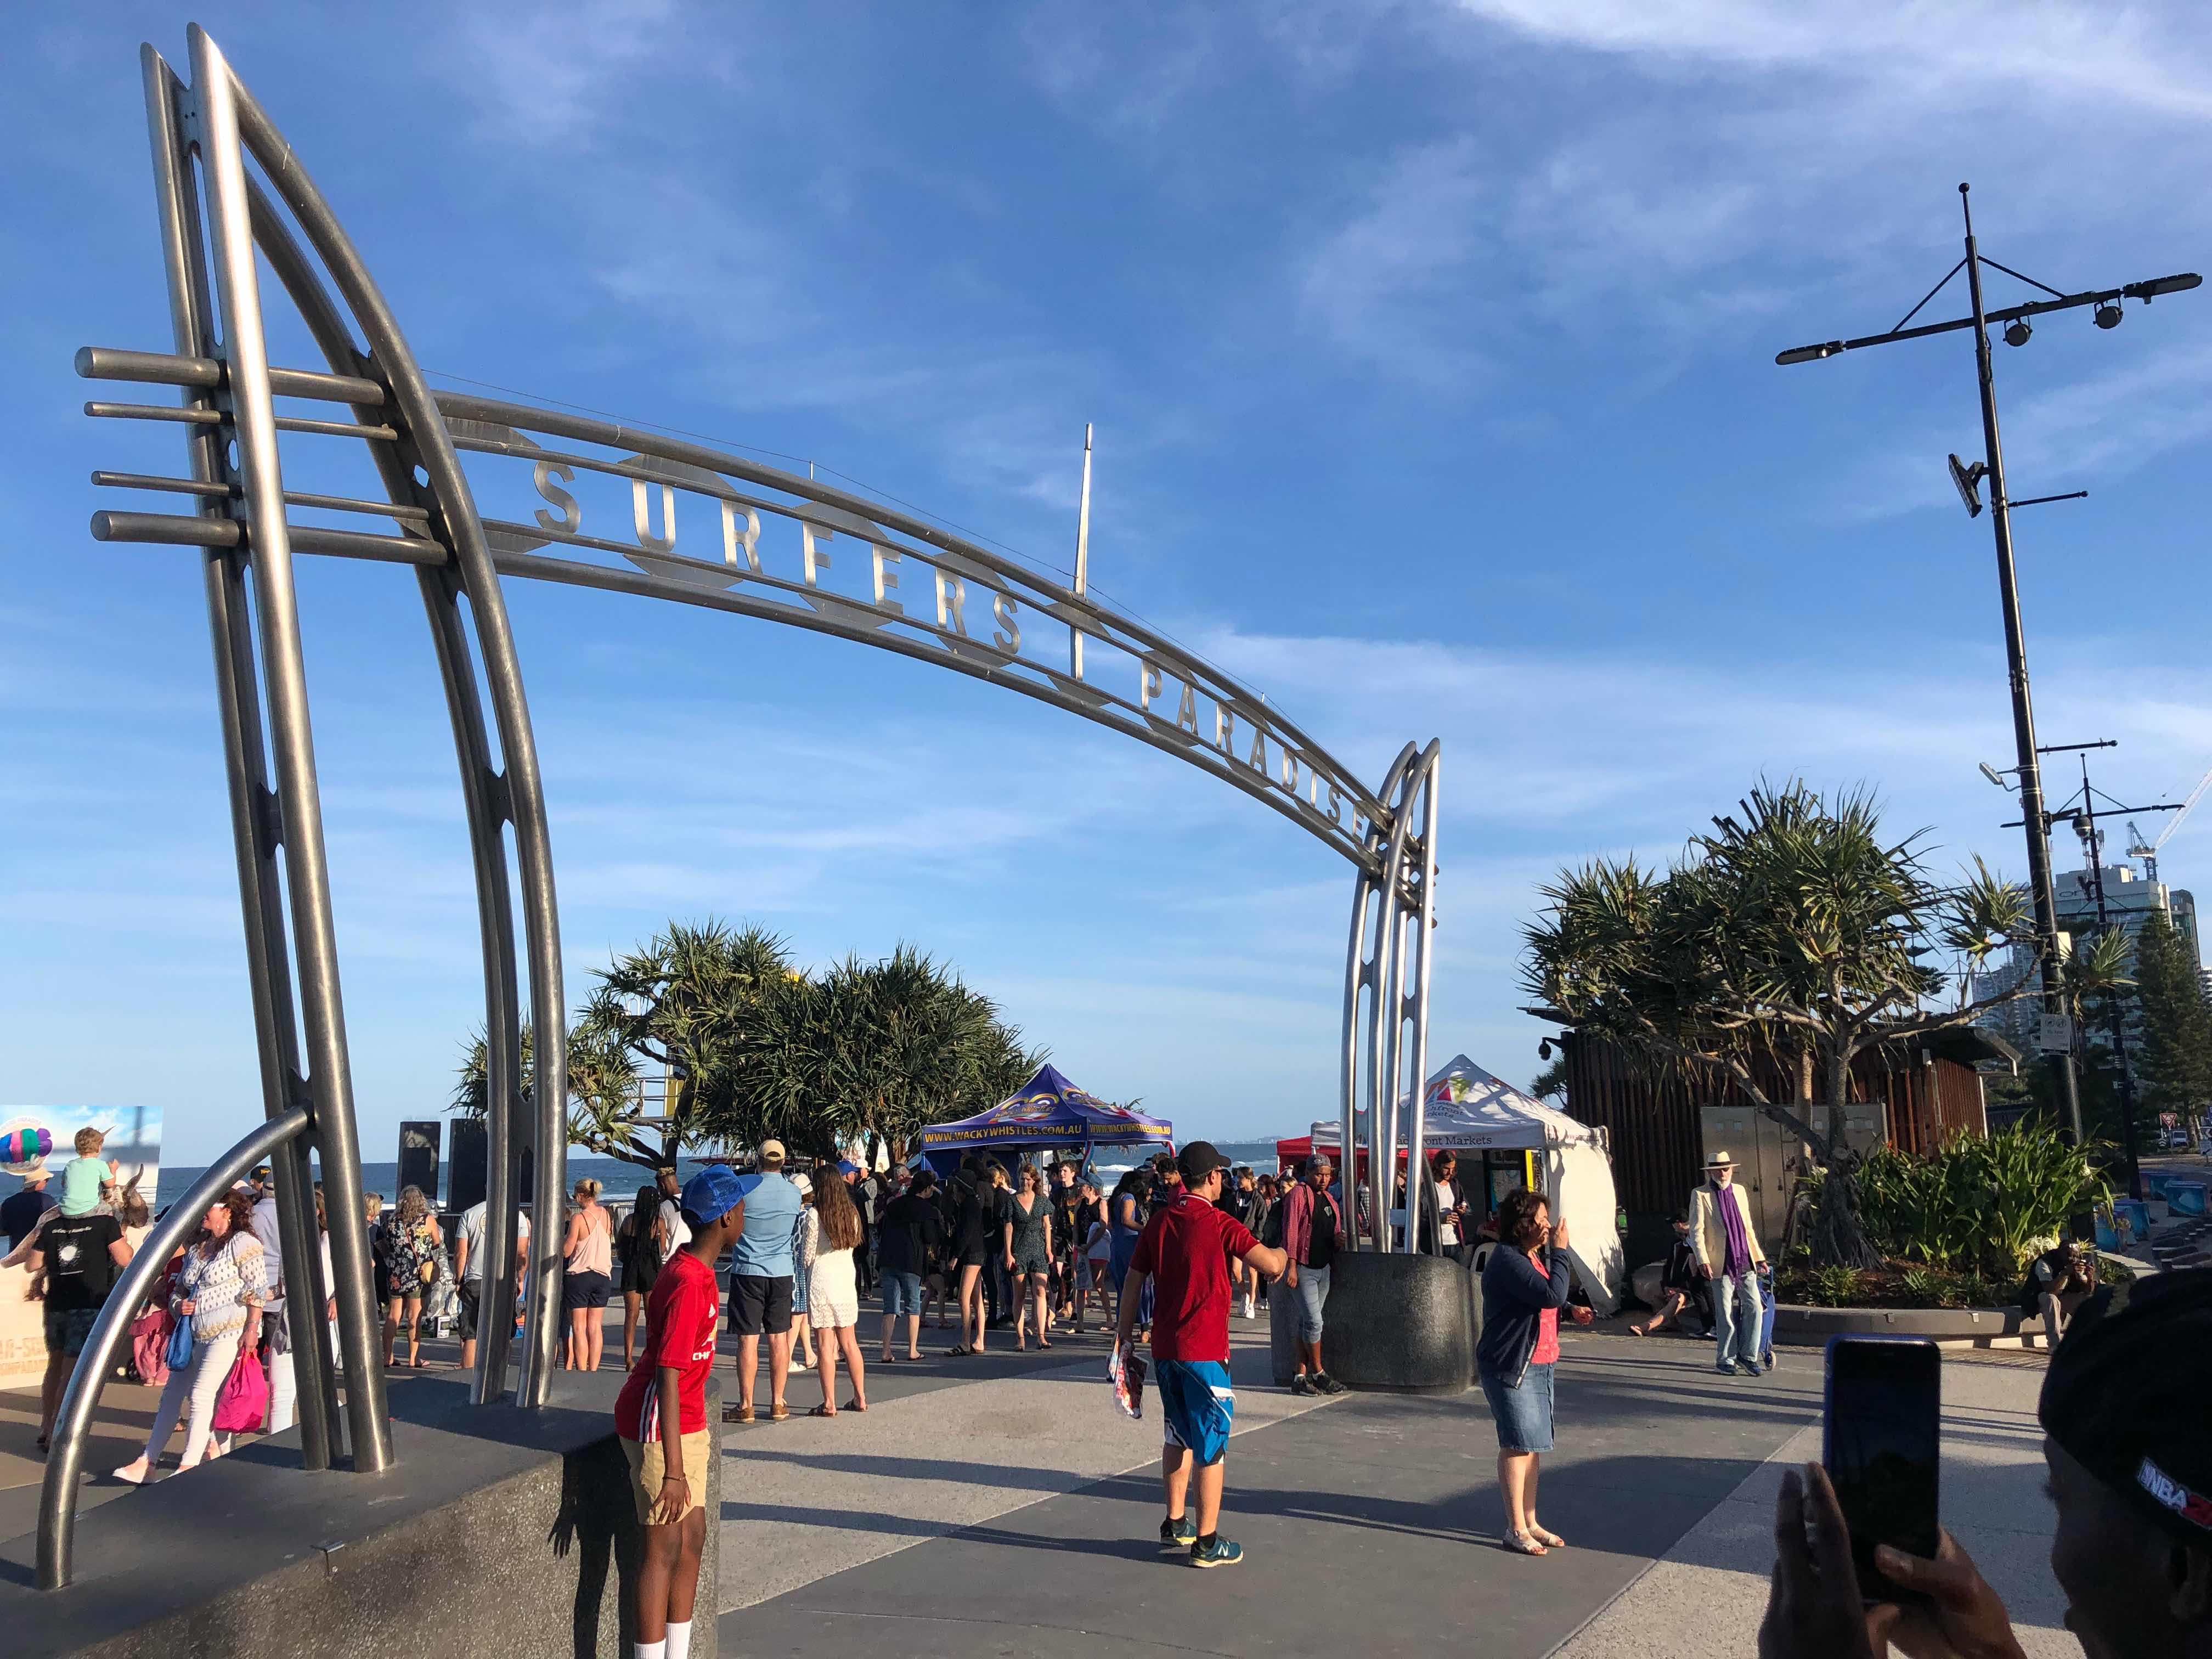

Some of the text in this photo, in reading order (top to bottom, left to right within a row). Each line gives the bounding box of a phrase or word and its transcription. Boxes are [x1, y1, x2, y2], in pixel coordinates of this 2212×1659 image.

[534, 460, 1364, 847] SURFERS PARADISE
[924, 1125, 1082, 1142] WWW.WACKYWHISTLES.COM.AU
[1445, 1136, 1492, 1145] Markets
